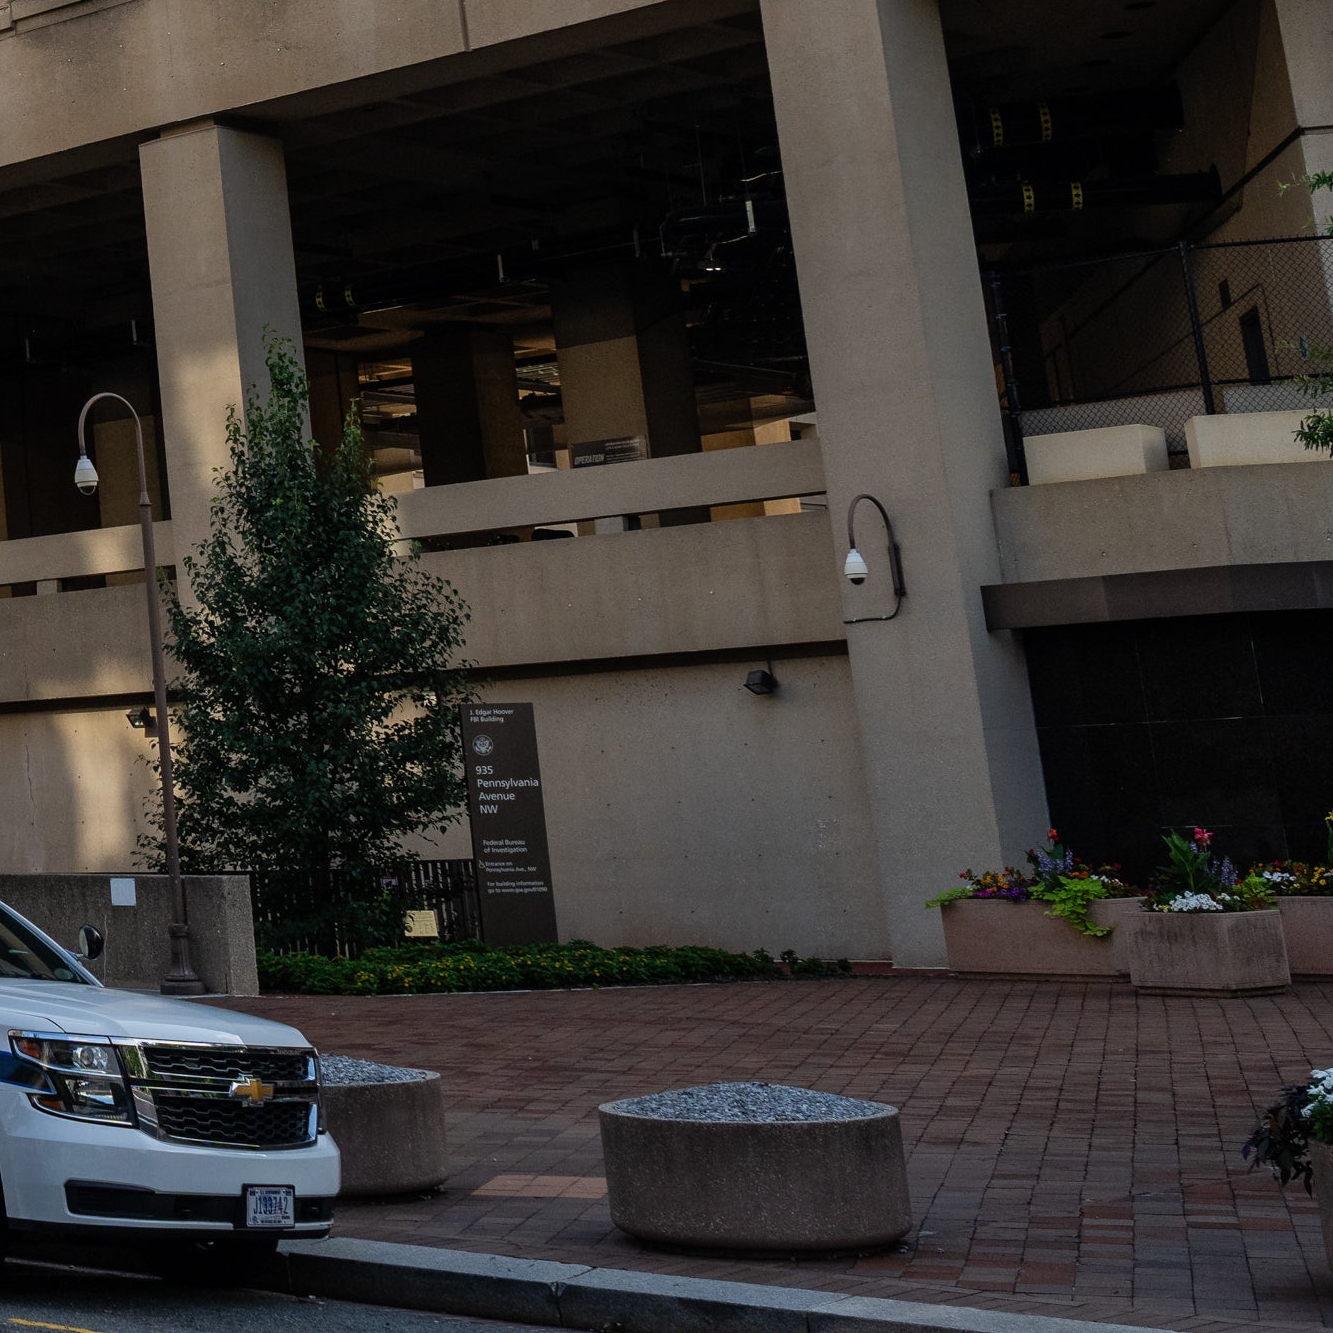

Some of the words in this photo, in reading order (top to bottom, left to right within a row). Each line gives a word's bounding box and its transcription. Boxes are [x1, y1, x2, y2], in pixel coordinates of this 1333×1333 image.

[475, 766, 493, 775] 935
[477, 778, 539, 789] Pennsylvania
[478, 792, 515, 801] Avenue
[480, 805, 498, 814] NW
